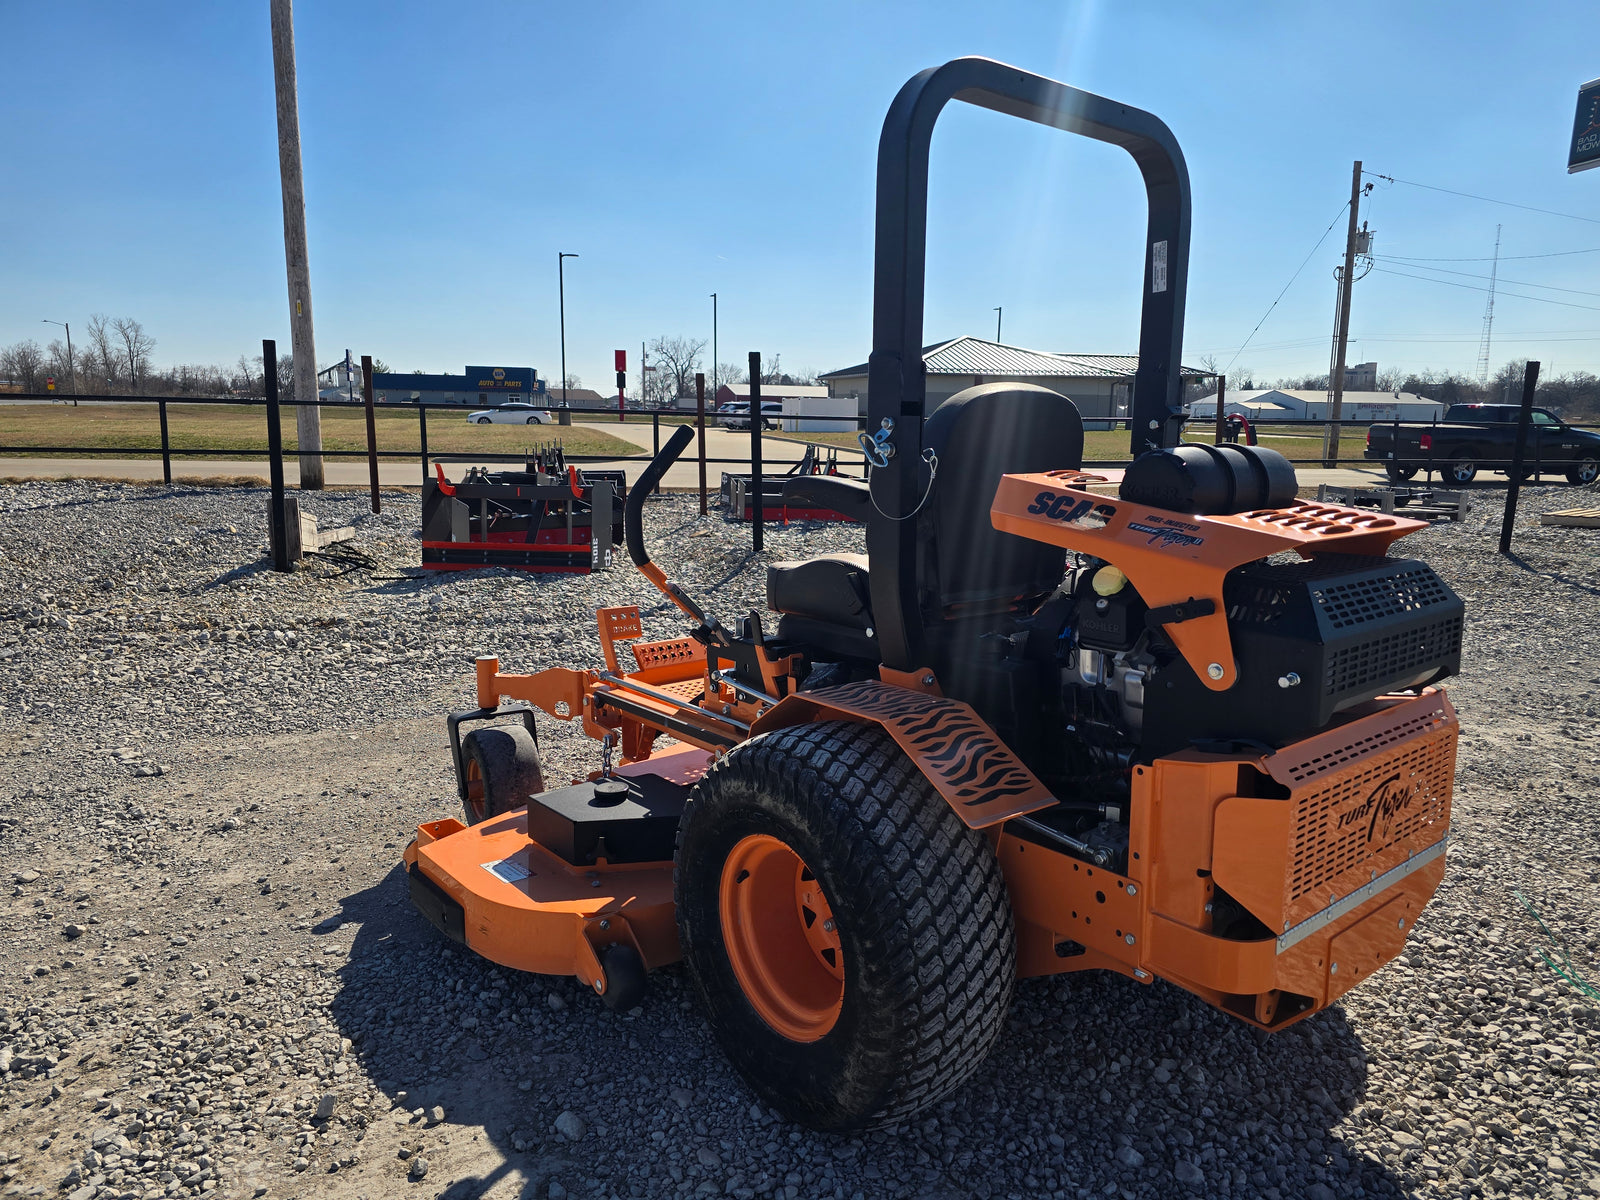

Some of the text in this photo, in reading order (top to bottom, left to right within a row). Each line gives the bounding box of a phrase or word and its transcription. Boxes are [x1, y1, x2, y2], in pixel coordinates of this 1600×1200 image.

[1577, 133, 1598, 145] BAD
[1145, 514, 1201, 532] FUEL-INJECTED
[1081, 619, 1120, 633] KOHLER
[1337, 799, 1376, 830] TURF
